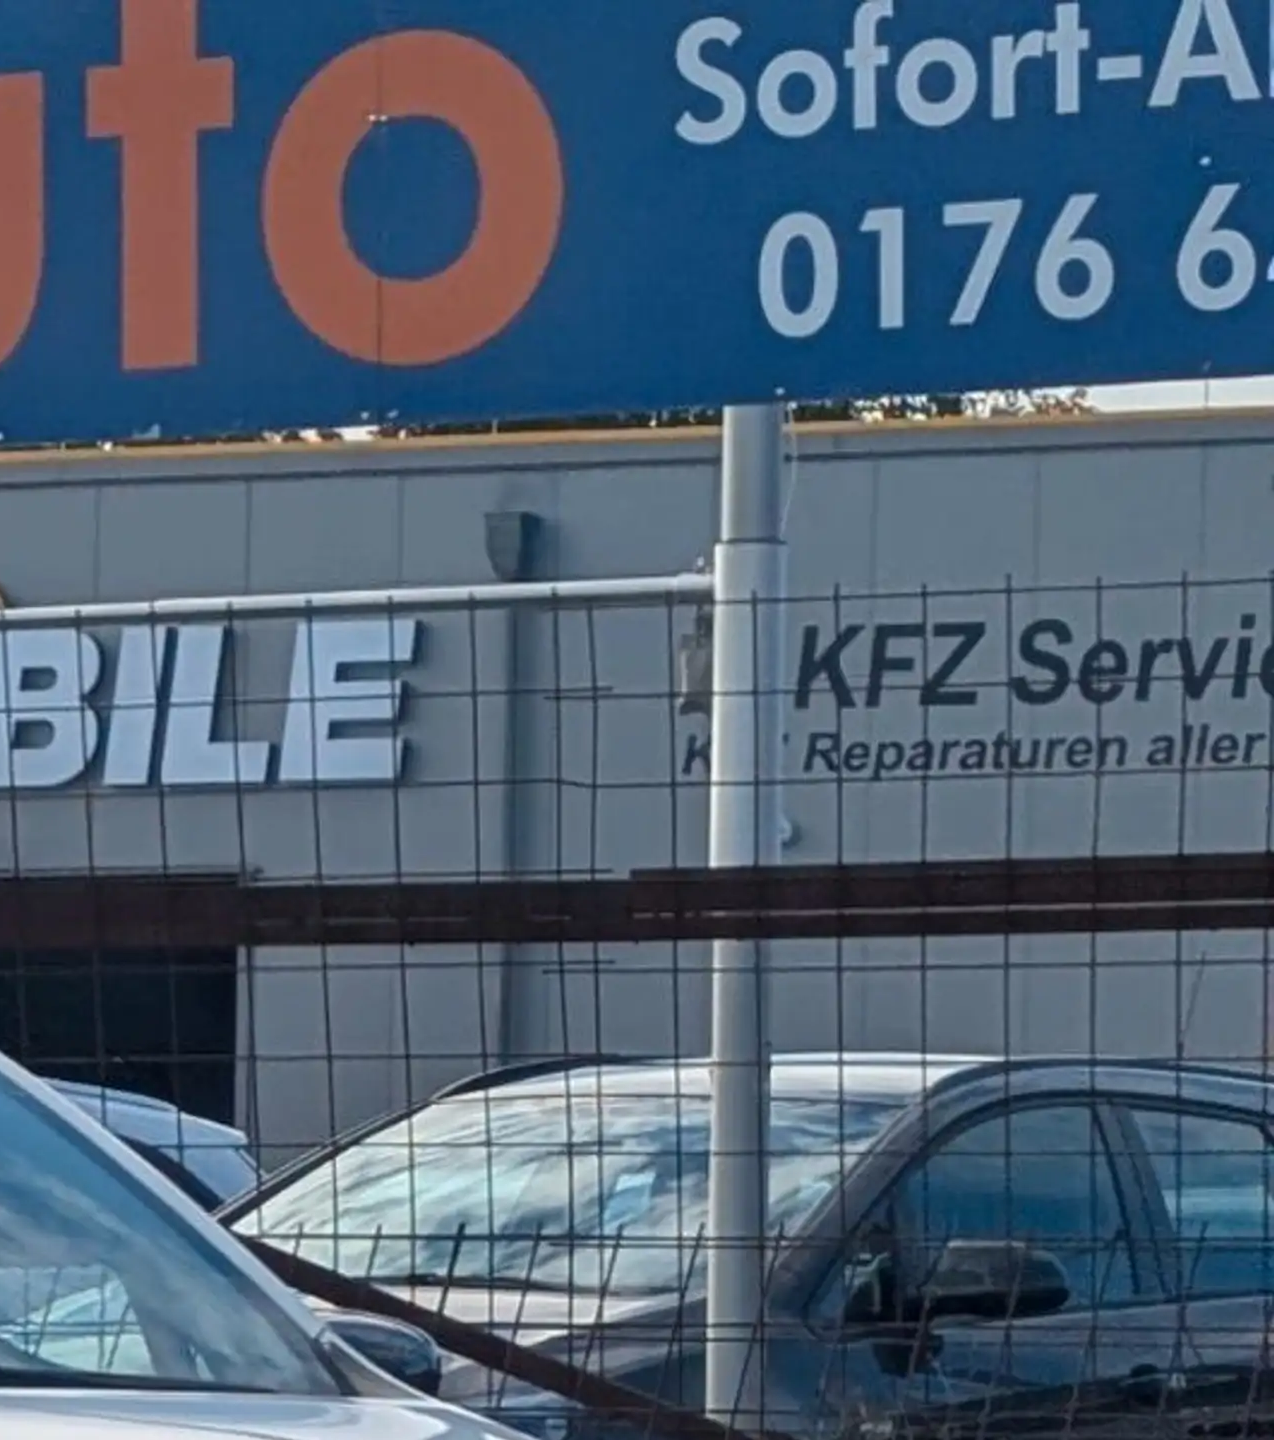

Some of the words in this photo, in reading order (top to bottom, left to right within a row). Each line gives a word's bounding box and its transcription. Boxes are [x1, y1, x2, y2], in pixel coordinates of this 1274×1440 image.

[674, 0, 1274, 145] Sofort-A
[757, 192, 1115, 338] 0176
[1176, 182, 1274, 312] 6
[792, 620, 986, 709] KFZ
[802, 729, 1128, 781] Reparaturen
[1145, 723, 1267, 767] aller
